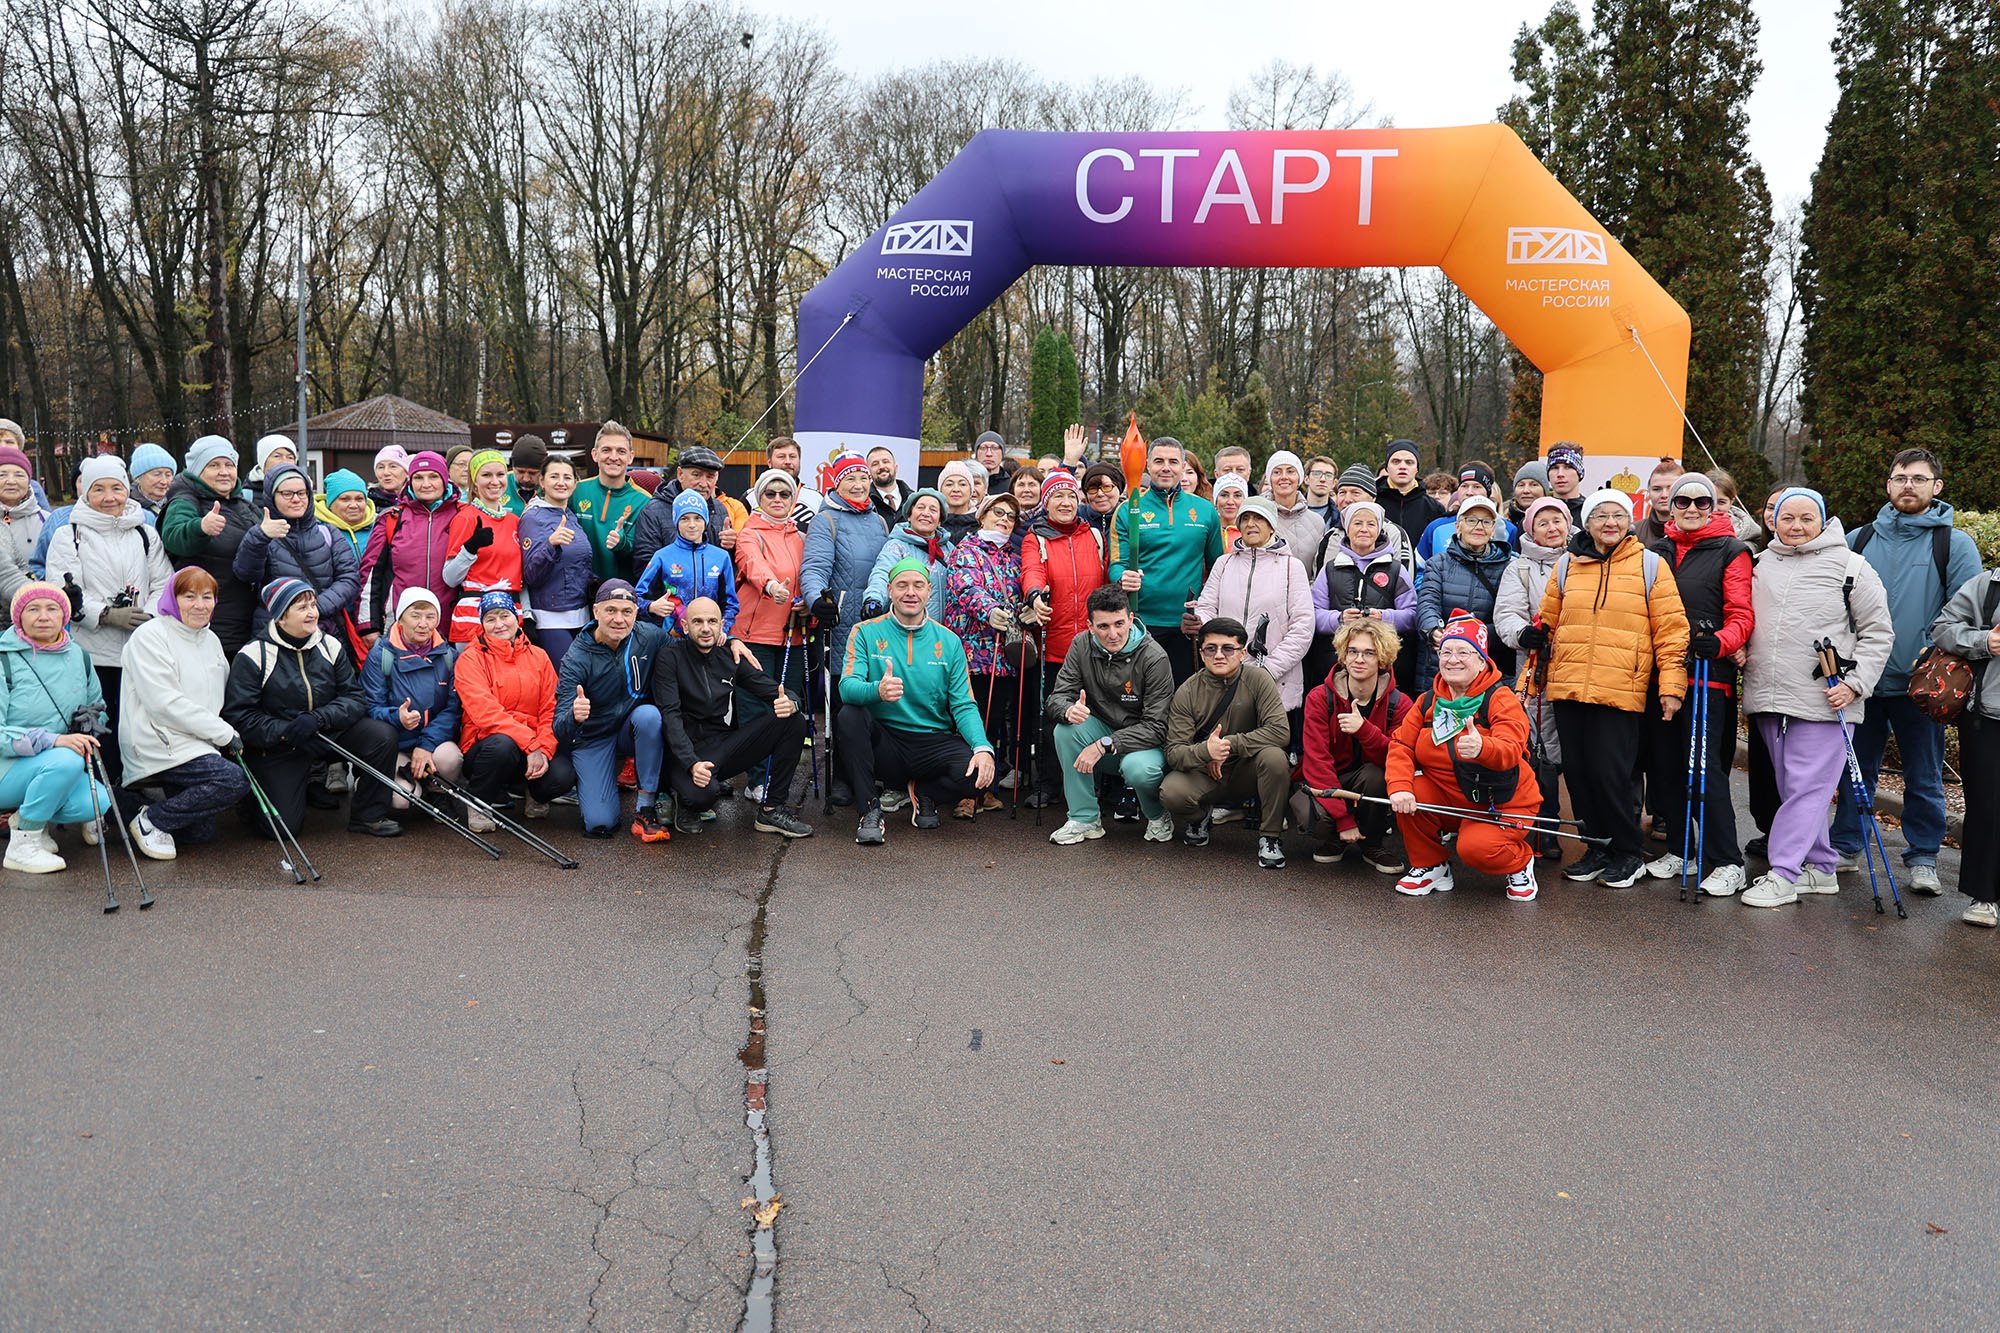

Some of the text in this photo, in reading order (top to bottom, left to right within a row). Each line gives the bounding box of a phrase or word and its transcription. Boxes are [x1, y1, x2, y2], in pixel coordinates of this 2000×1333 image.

[1076, 148, 1398, 225] СТАРТ
[877, 268, 971, 281] МАСТЕРСКАЯ
[911, 284, 970, 297] РОССИИ
[1506, 279, 1610, 292] МАСТЕРСКАЯ
[1542, 295, 1610, 308] РОССИИ
